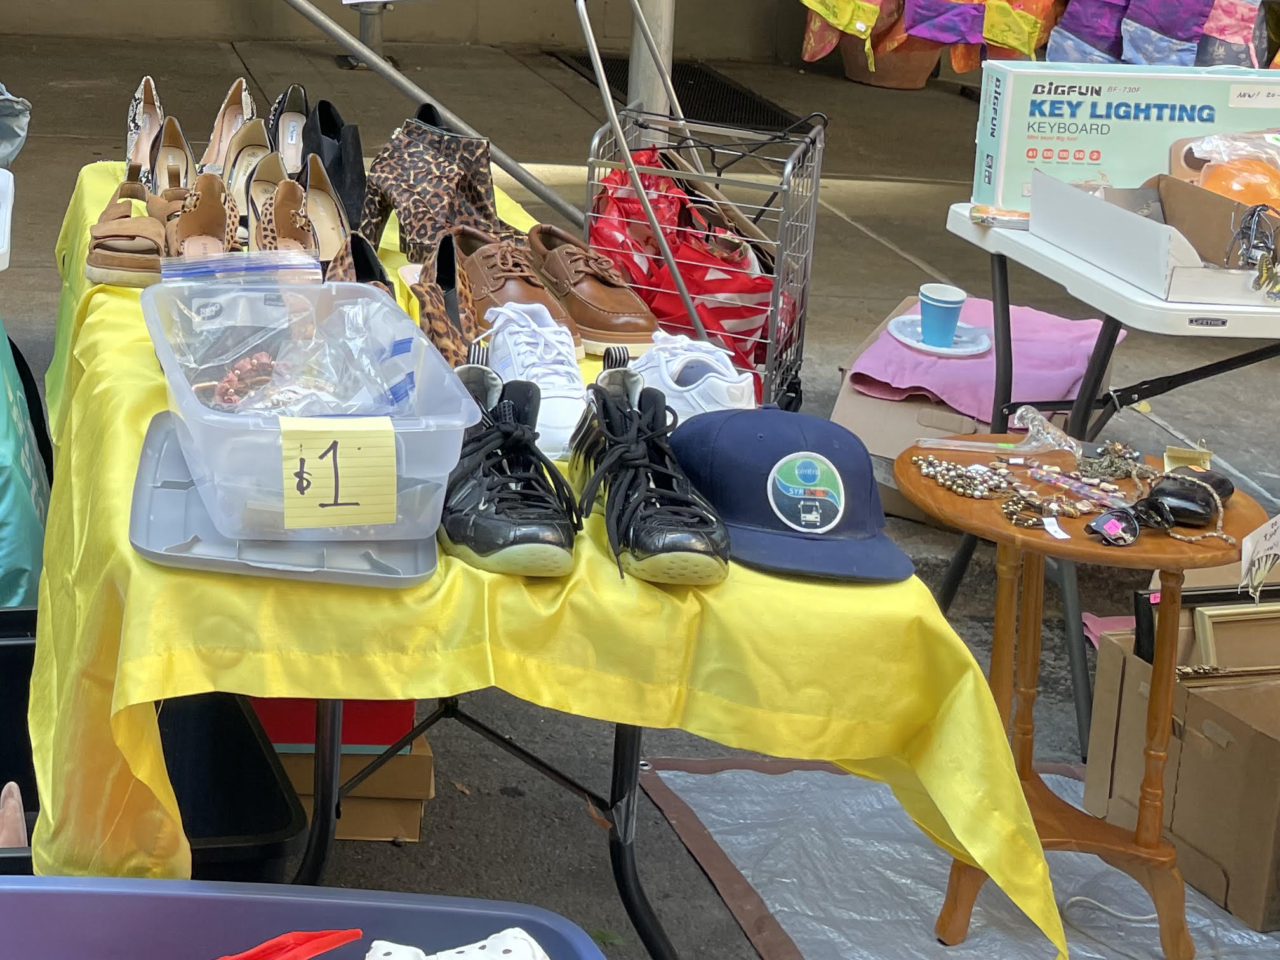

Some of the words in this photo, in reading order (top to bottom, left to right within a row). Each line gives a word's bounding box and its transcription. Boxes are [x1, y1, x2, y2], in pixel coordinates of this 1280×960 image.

[1028, 99, 1085, 119] KEY
[1089, 101, 1217, 124] LIGHTING
[1027, 121, 1111, 135] KEYBOARD
[292, 440, 361, 509] $1
[788, 487, 805, 496] SYR
